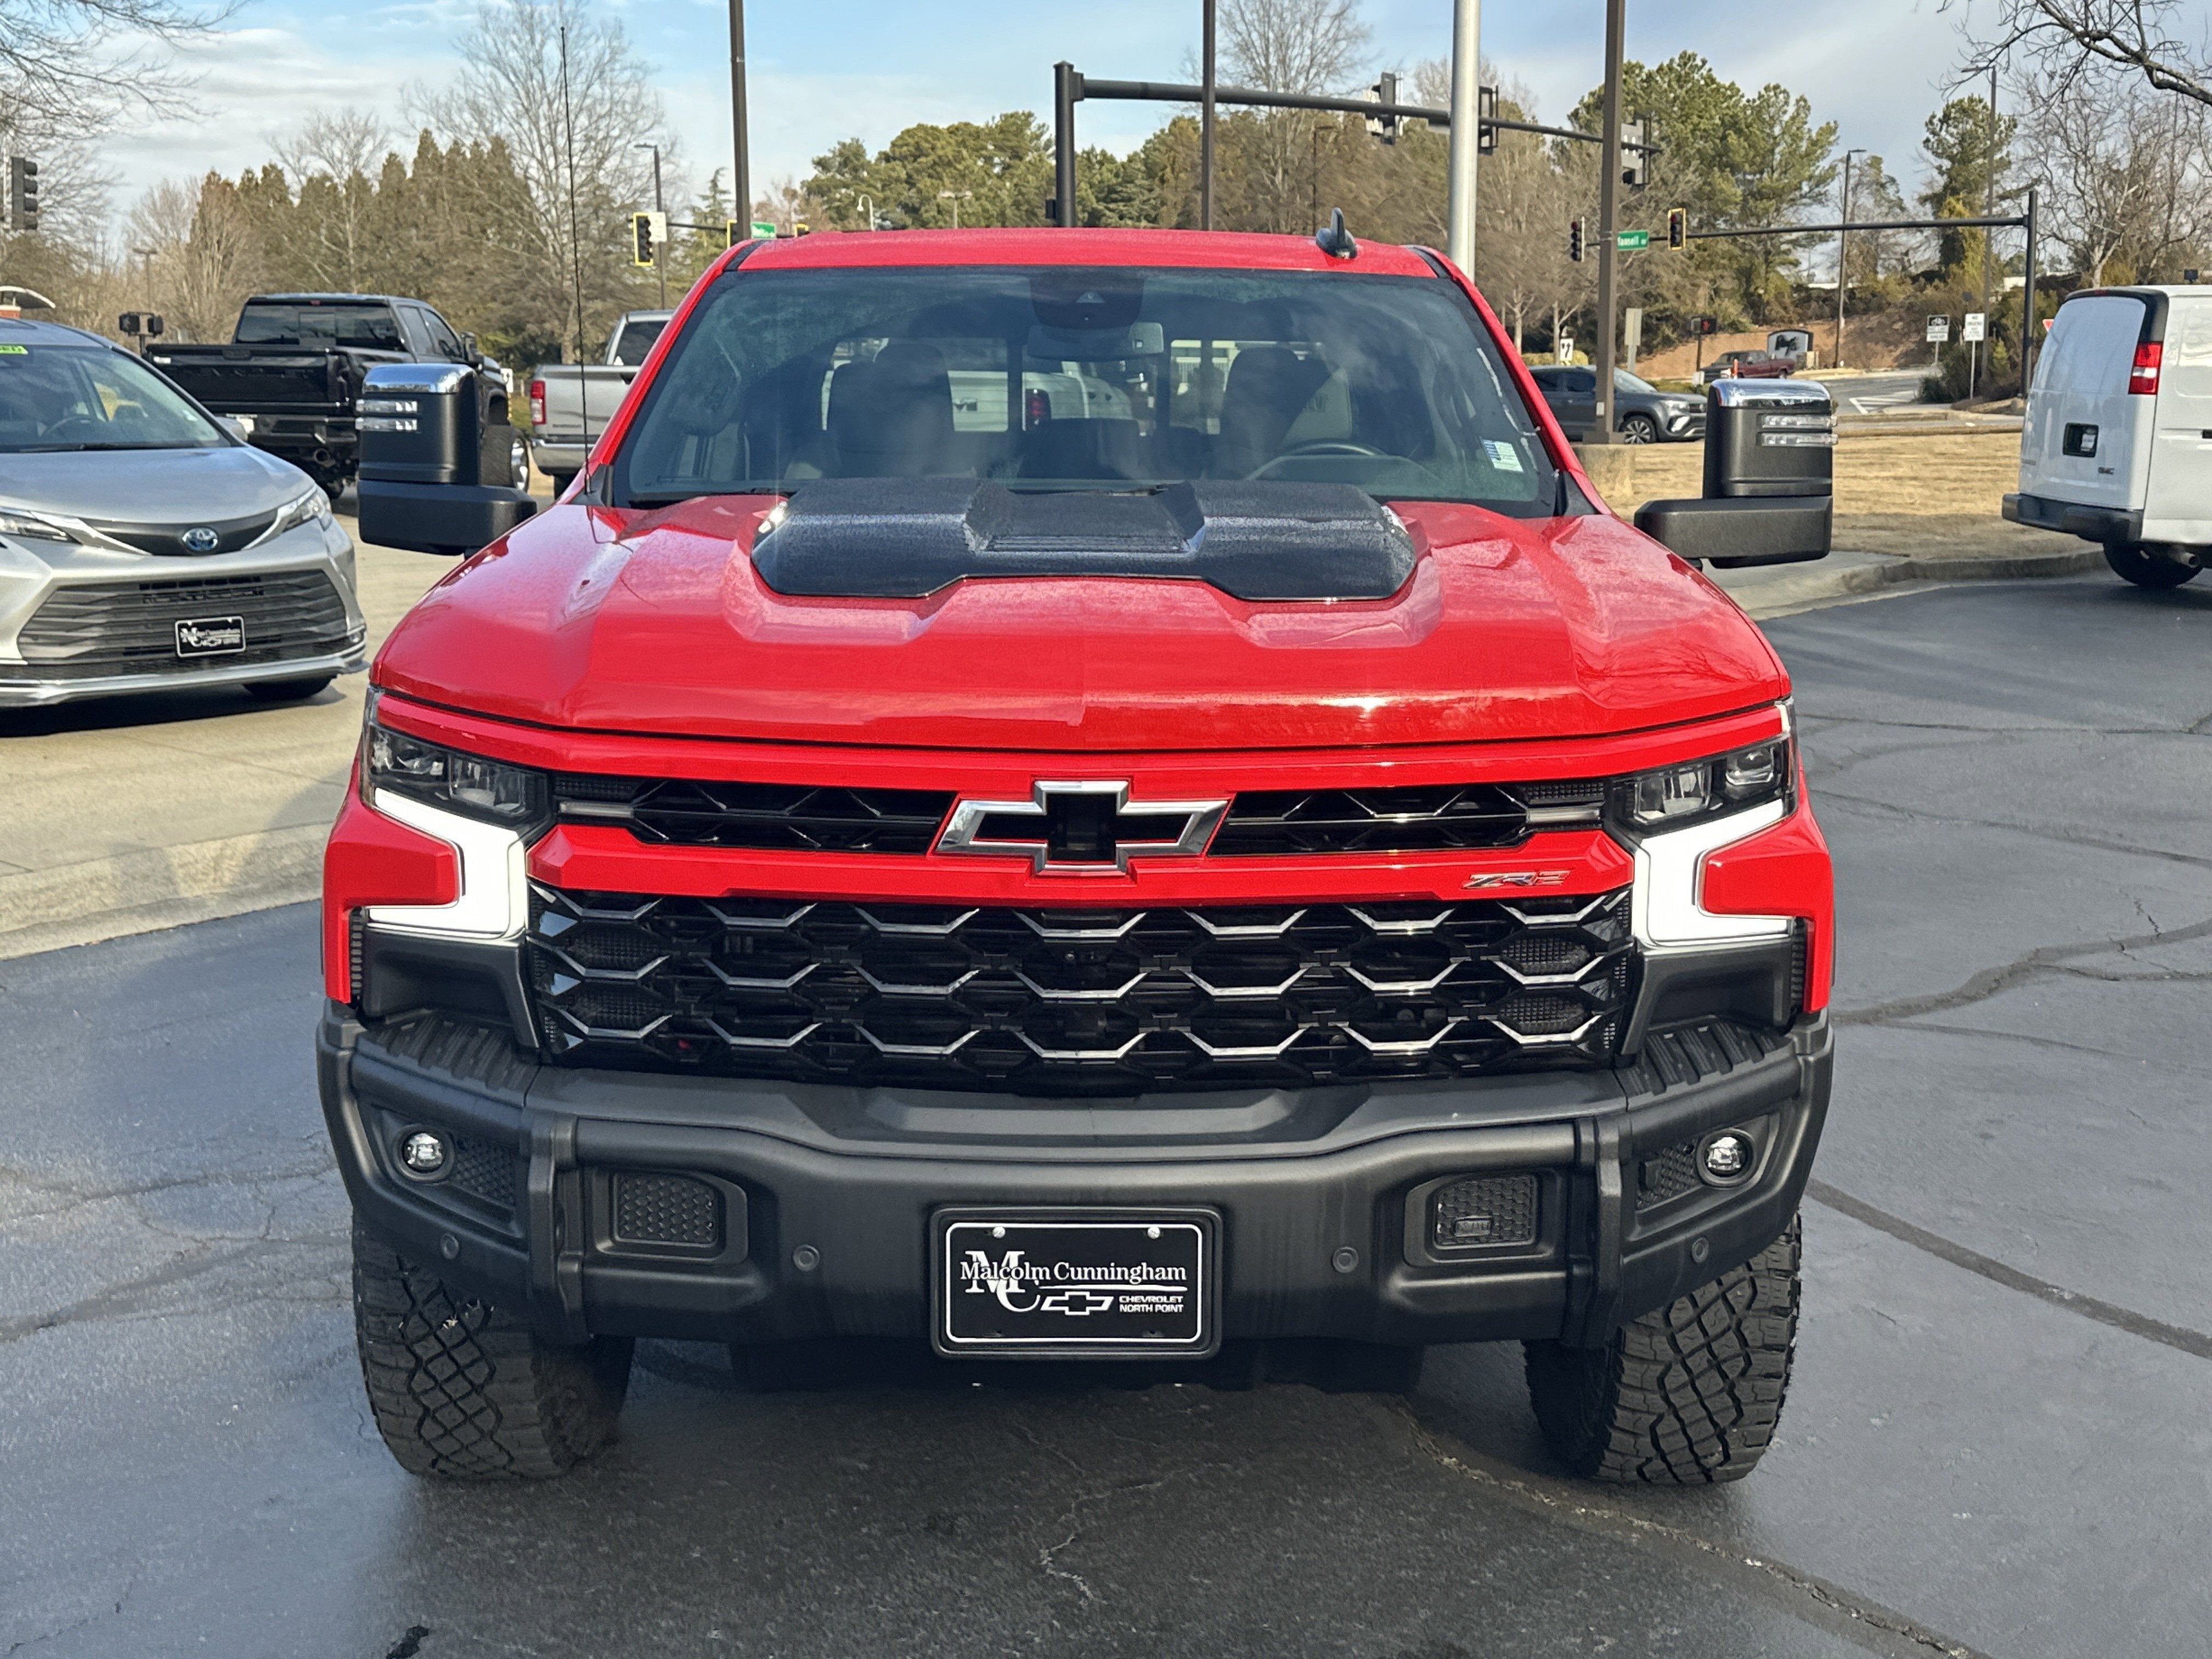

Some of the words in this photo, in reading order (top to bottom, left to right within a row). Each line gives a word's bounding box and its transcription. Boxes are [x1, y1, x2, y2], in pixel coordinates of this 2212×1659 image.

[1463, 870, 1571, 889] ZR2
[960, 1262, 1051, 1280] Malcolm
[1053, 1262, 1186, 1285] Cunningham
[1119, 1295, 1183, 1304] CHEVROLET
[1120, 1304, 1153, 1312] NORTH
[1155, 1304, 1184, 1312] POINT
